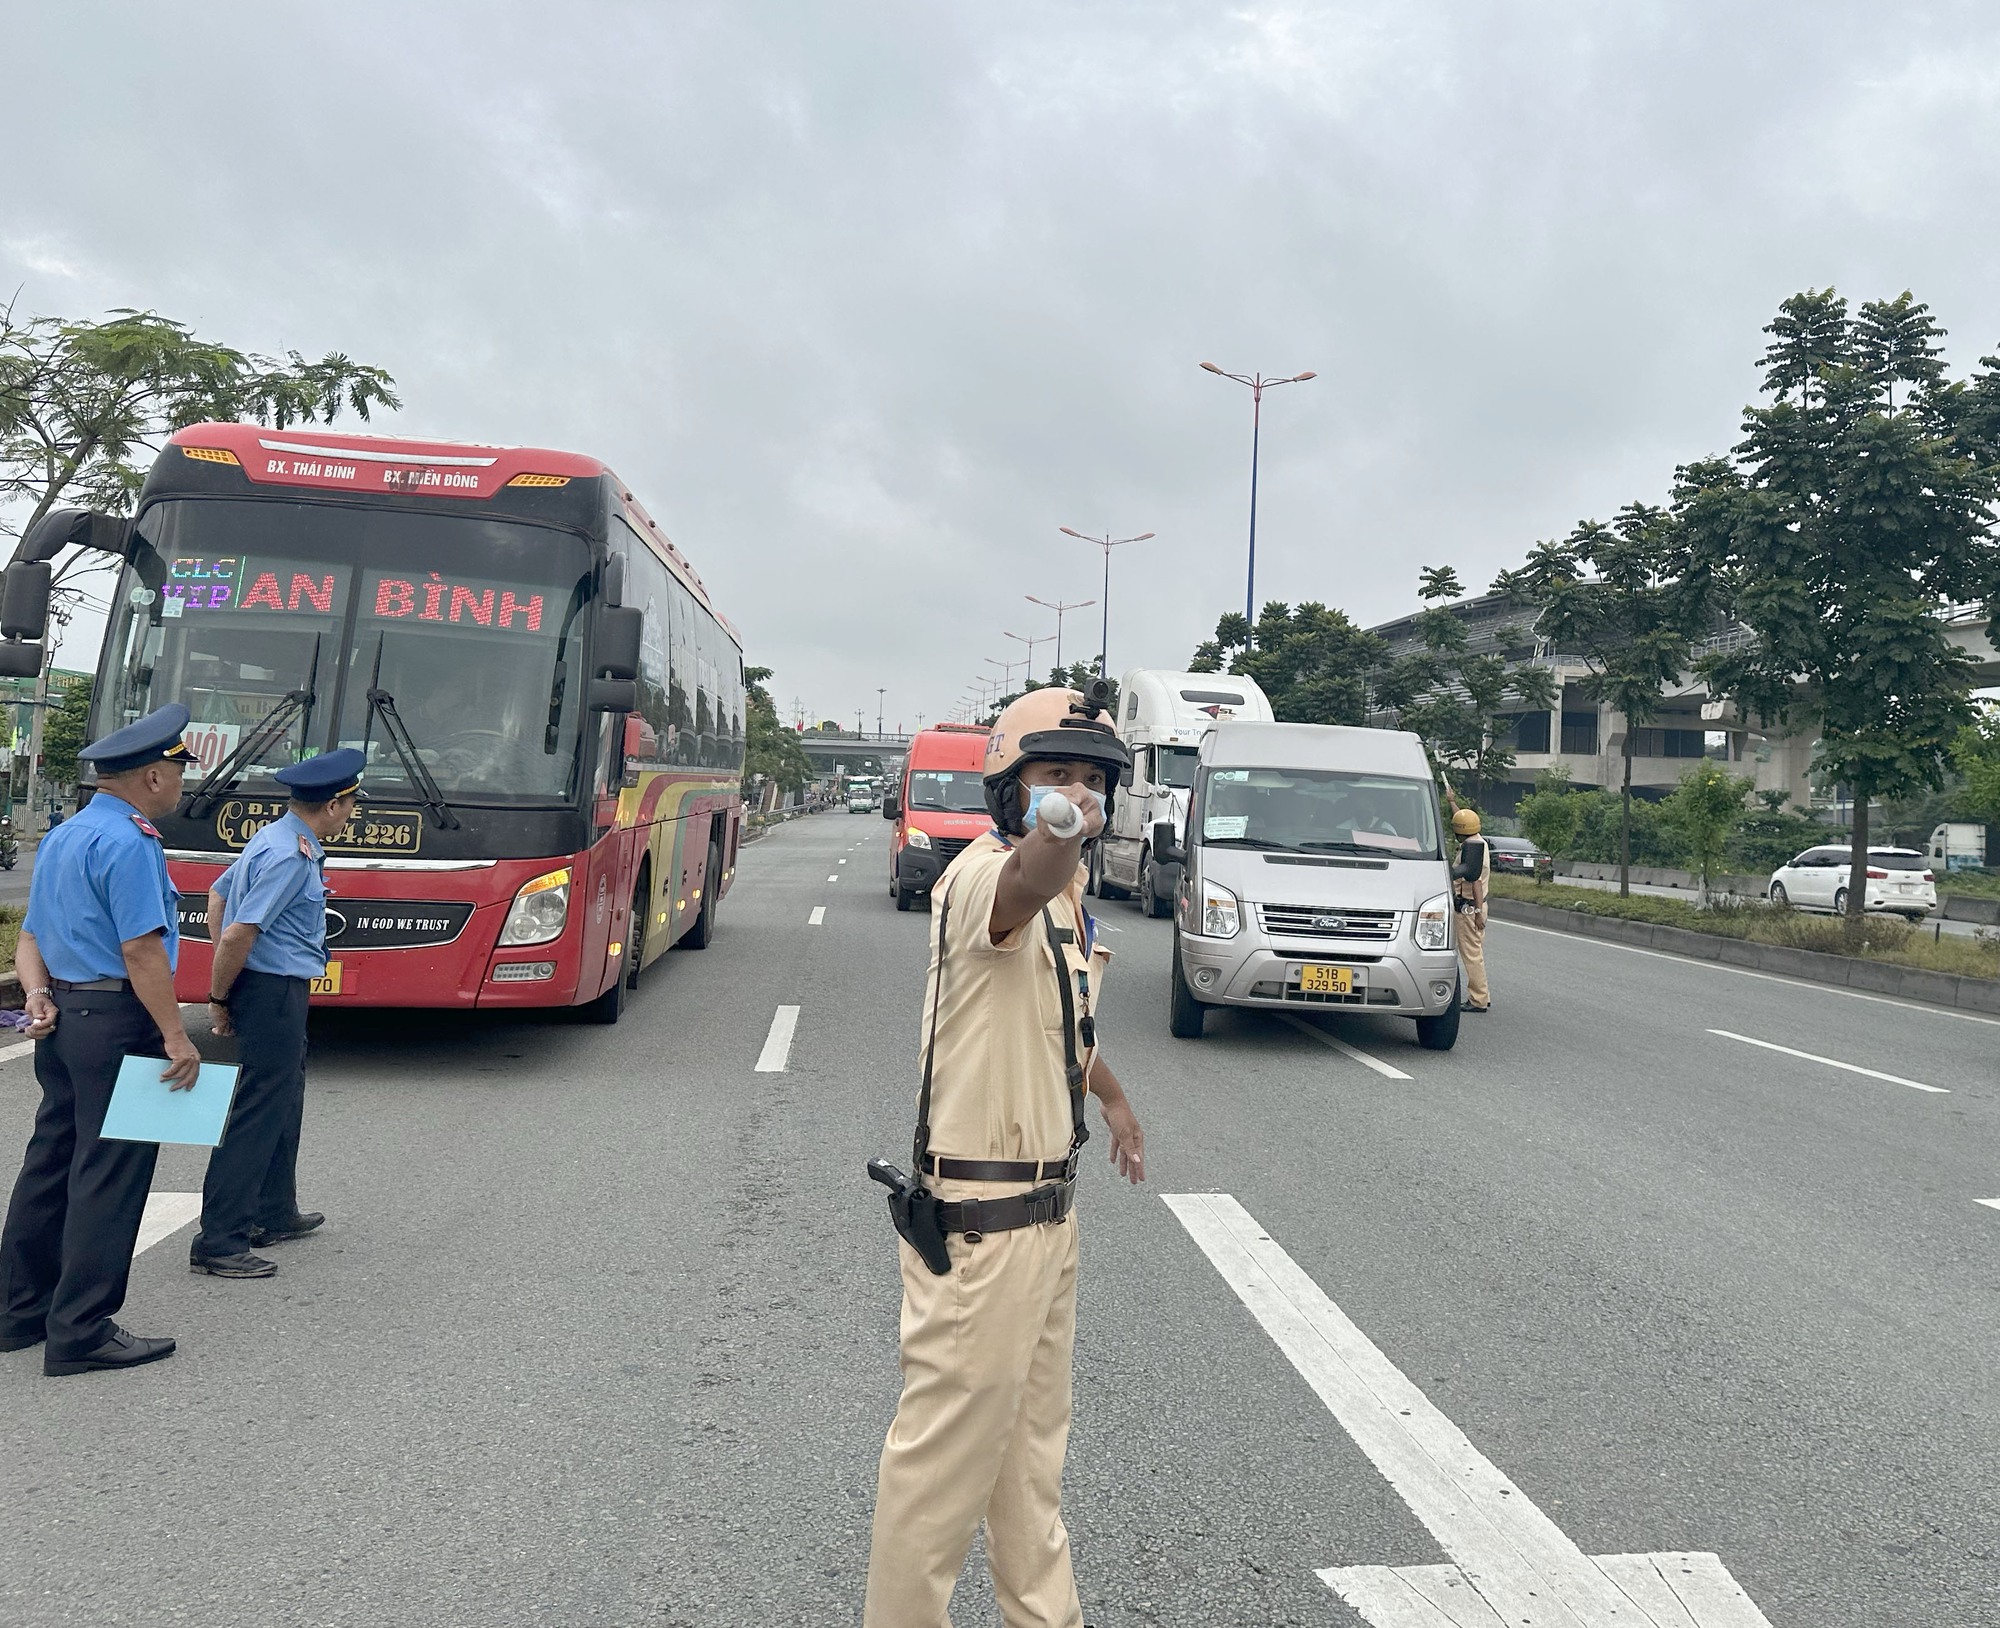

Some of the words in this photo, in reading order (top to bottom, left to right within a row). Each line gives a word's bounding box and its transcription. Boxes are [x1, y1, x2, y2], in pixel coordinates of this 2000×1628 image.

[267, 459, 289, 474] BX.
[293, 460, 322, 477] THÁI
[383, 469, 404, 484] BX.
[443, 471, 479, 489] ĐÔNG
[171, 558, 236, 578] CLC
[161, 585, 232, 608] VIP
[240, 572, 335, 612] AN
[374, 570, 544, 631] BÌNH
[1174, 728, 1191, 736] Your
[185, 724, 228, 779] NỘI
[357, 917, 370, 929] IN
[371, 917, 394, 930] GOD
[397, 918, 413, 930] WE
[415, 919, 450, 931] TRUST
[1320, 919, 1338, 927] Ford
[1316, 968, 1338, 980] 51B
[1307, 979, 1346, 992] 329.50
